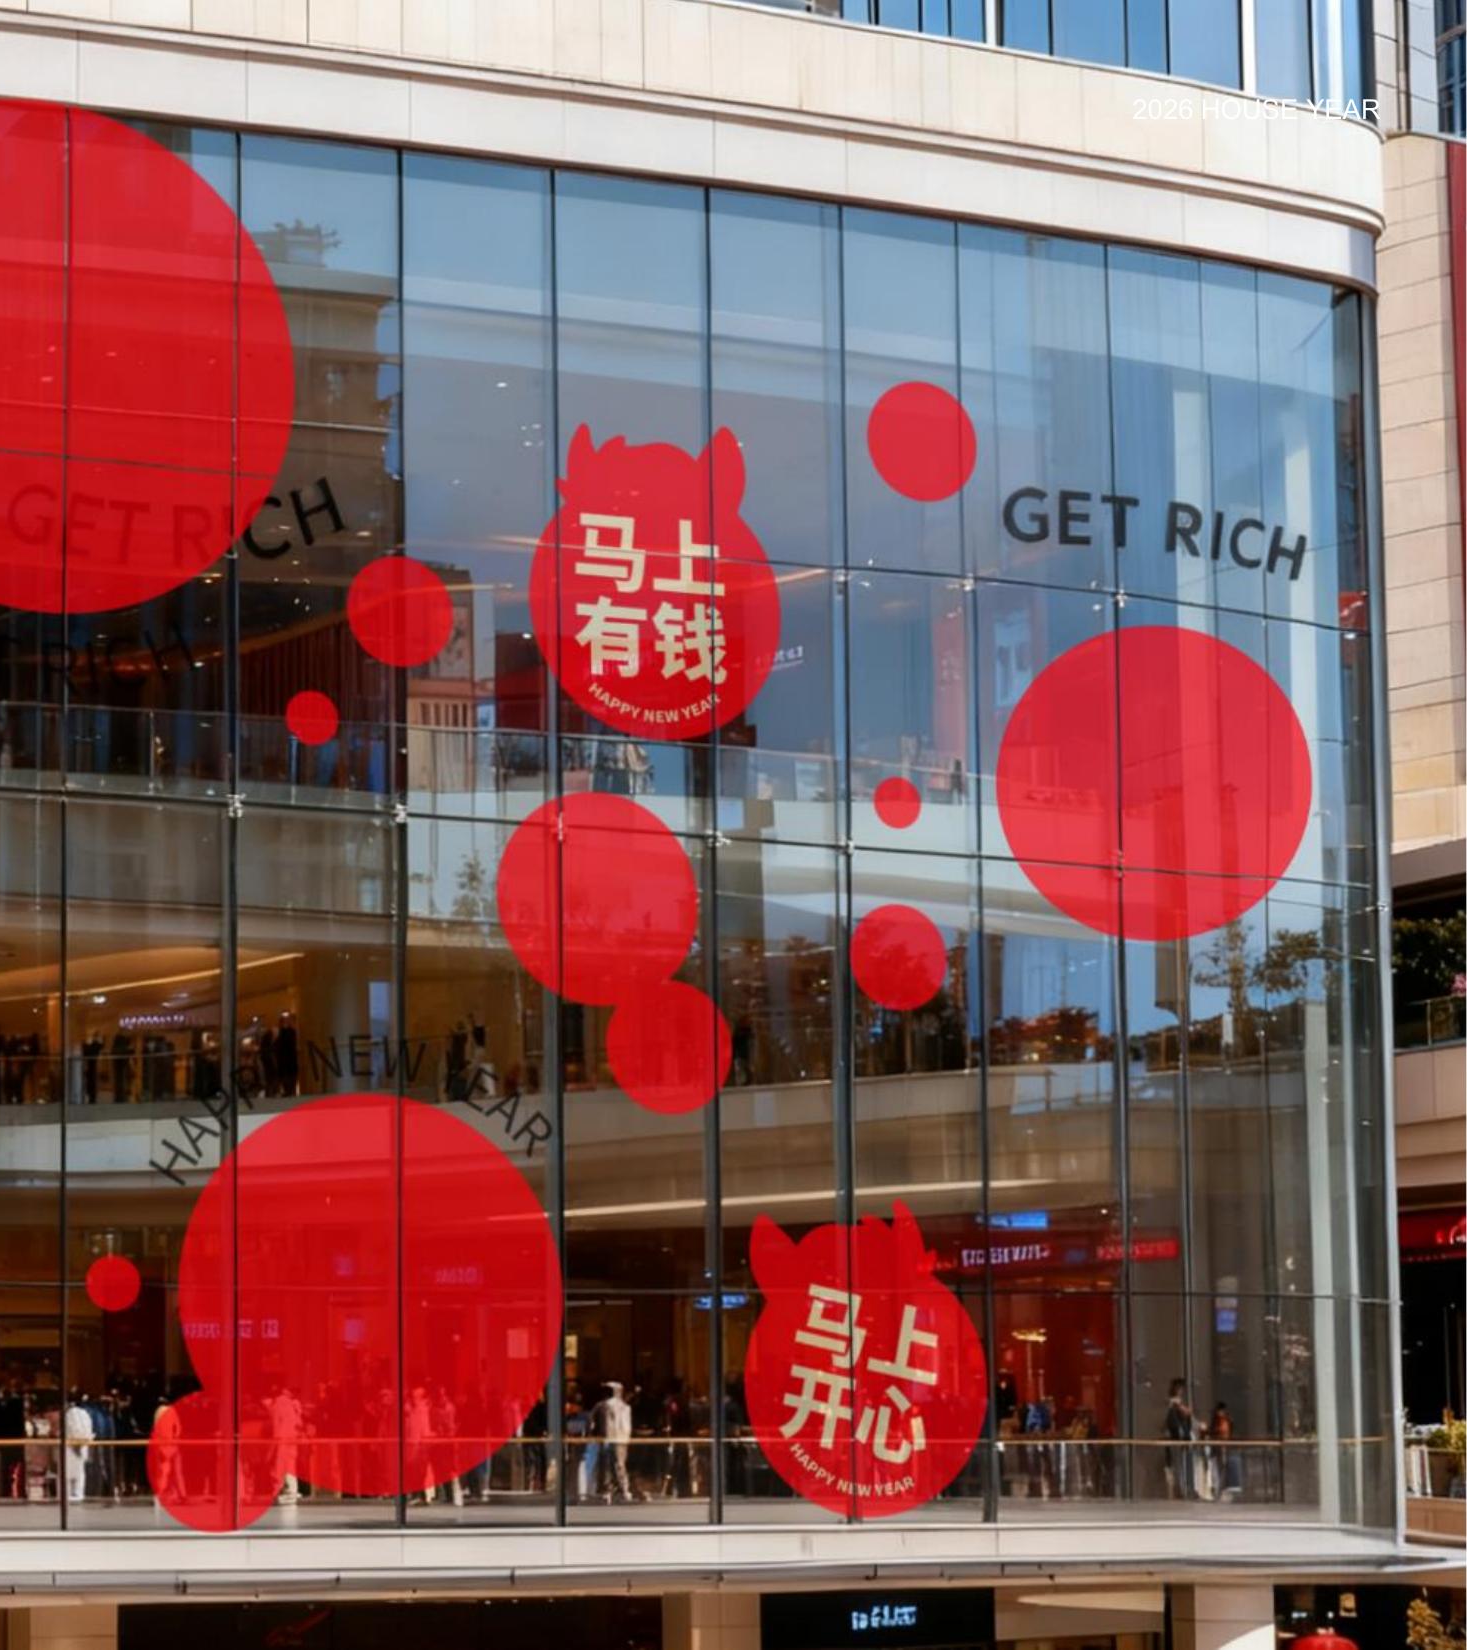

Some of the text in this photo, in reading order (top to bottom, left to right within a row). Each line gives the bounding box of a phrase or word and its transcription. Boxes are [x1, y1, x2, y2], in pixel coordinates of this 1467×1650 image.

[8, 477, 346, 570] GET RICH
[575, 512, 725, 597] 马上
[1002, 486, 1308, 581] GET RICH
[575, 595, 728, 685] 有钱
[588, 682, 722, 724] HAPPY NEW YEAR
[149, 1055, 283, 1186] HAPP
[307, 1034, 428, 1083] NEW
[794, 1283, 939, 1386] 马上
[779, 1363, 927, 1465] 开心
[790, 1442, 915, 1497] HAPPY NEW YEAR
